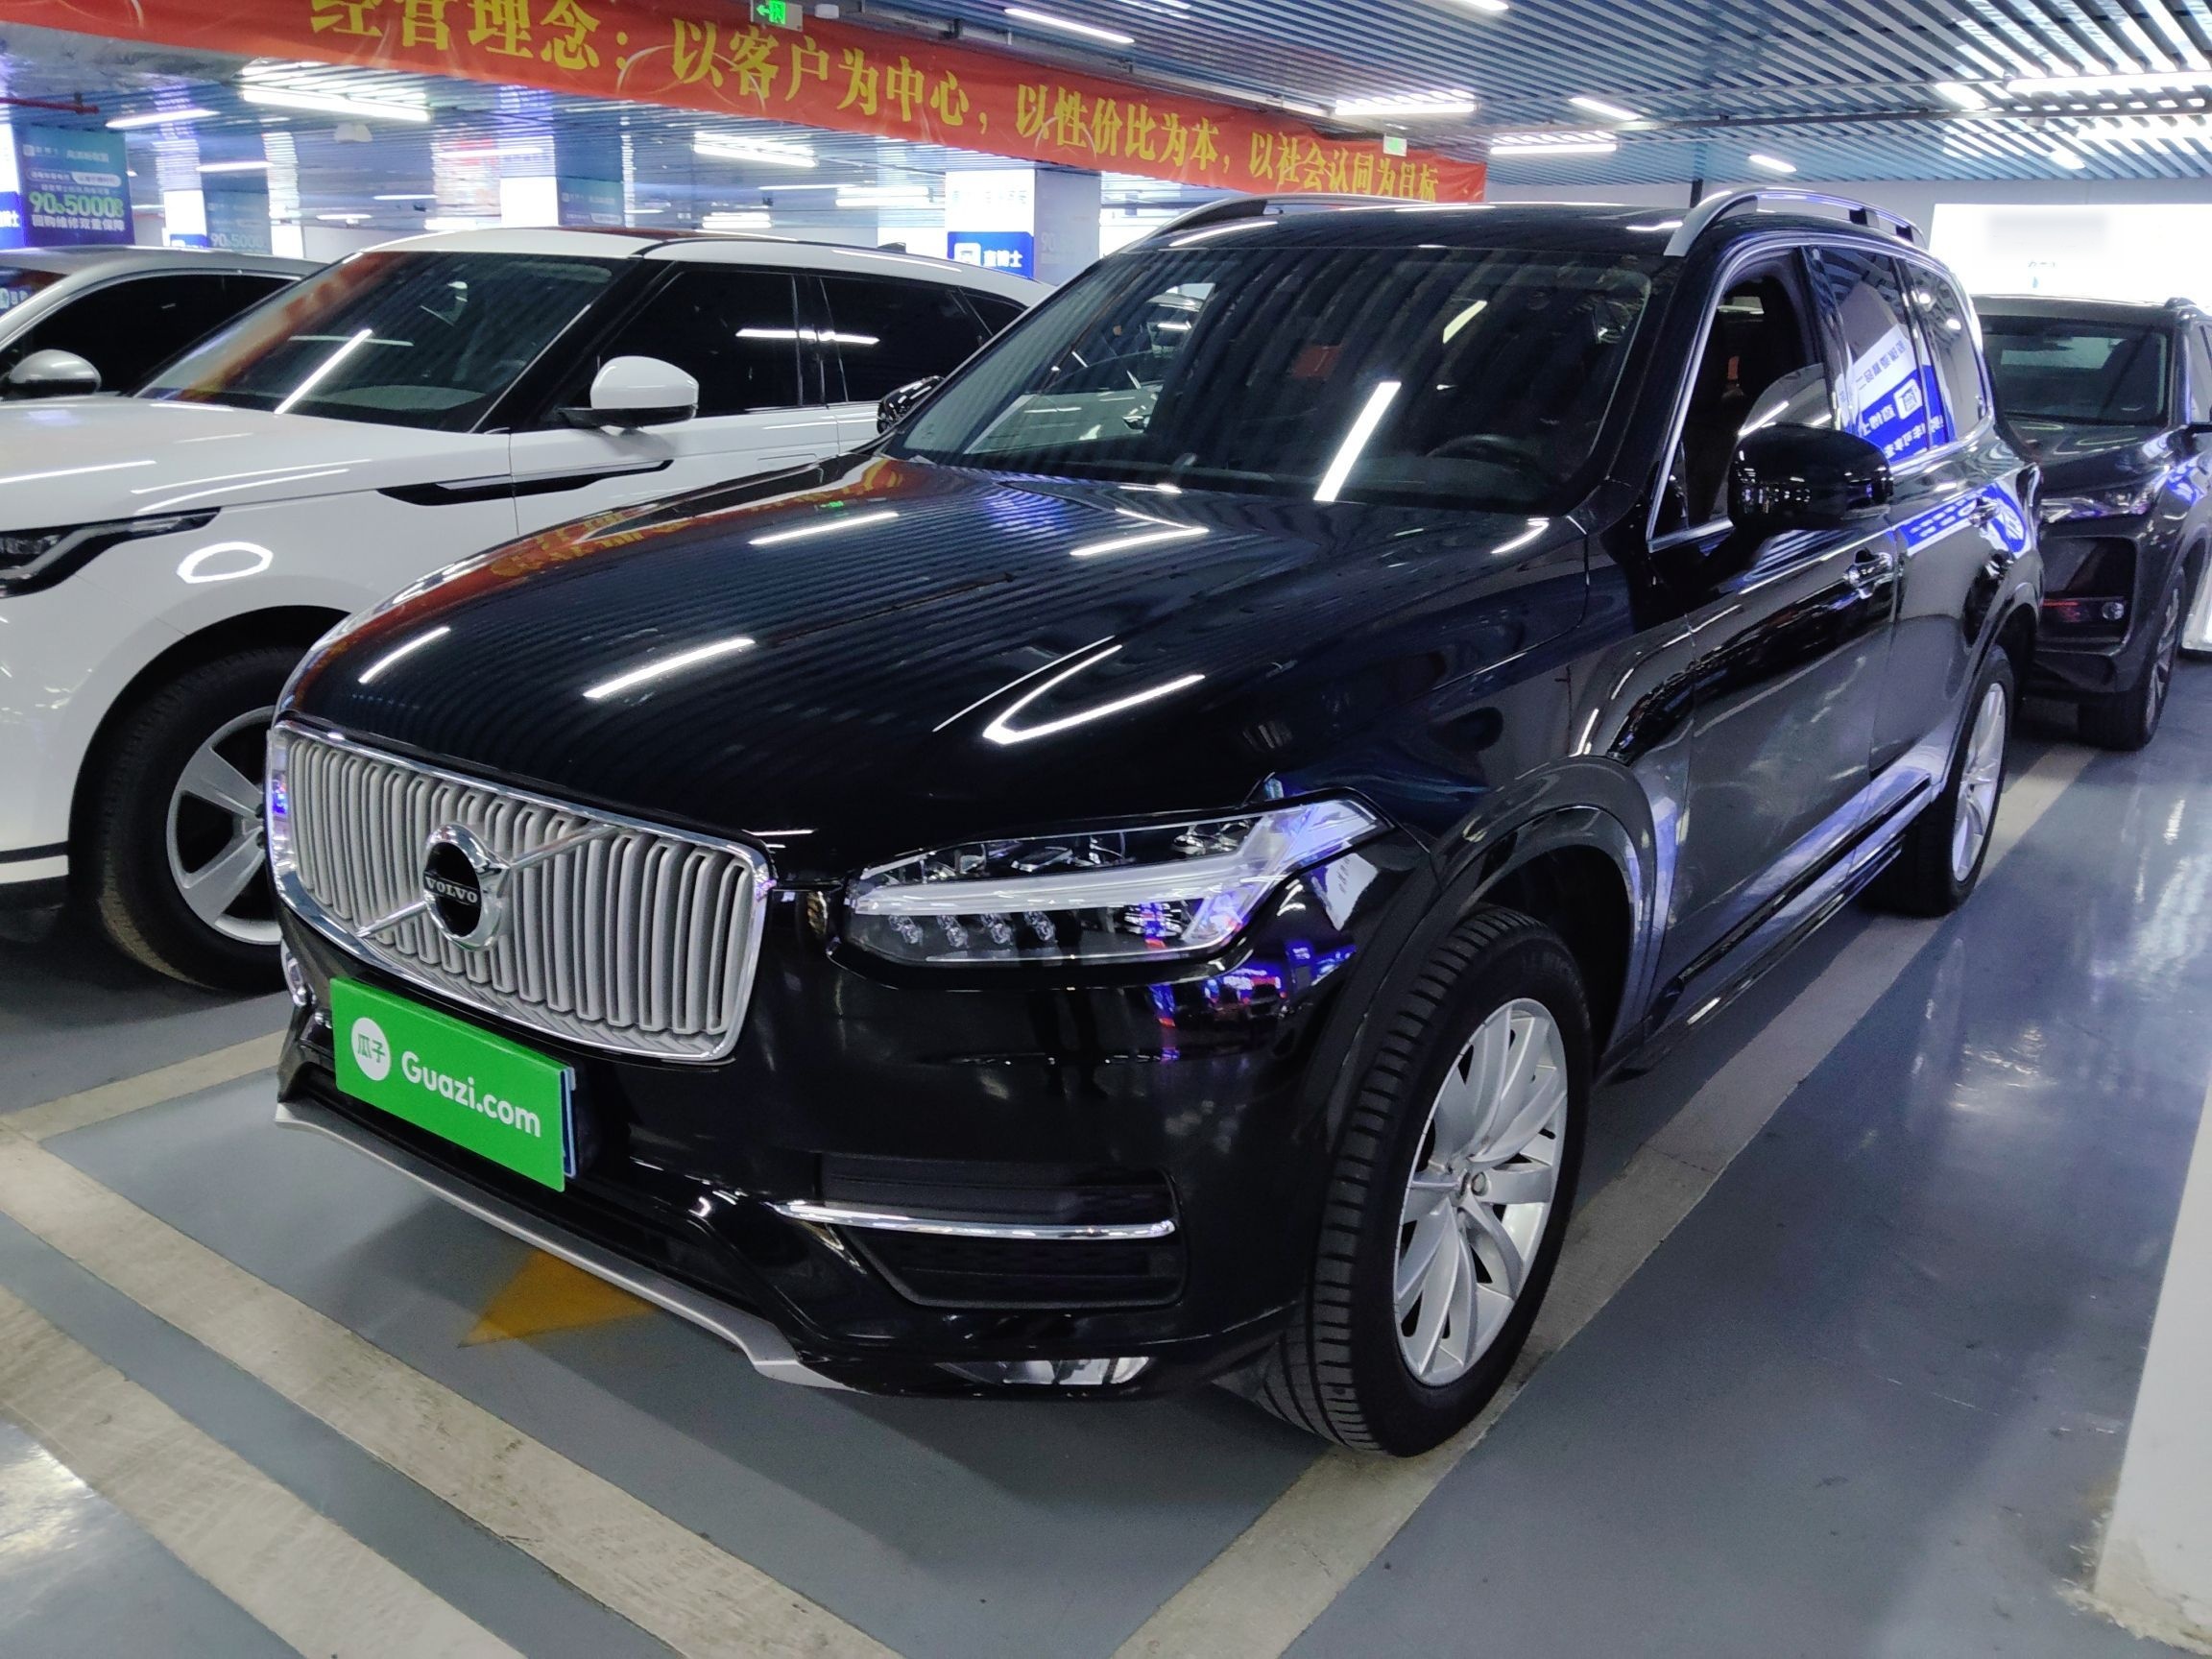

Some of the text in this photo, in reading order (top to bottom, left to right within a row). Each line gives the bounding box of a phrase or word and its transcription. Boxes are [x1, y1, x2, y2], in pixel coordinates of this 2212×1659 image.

[425, 876, 478, 904] VOLVO
[356, 1034, 386, 1065] 瓜子
[401, 1050, 541, 1139] Guazi.com
